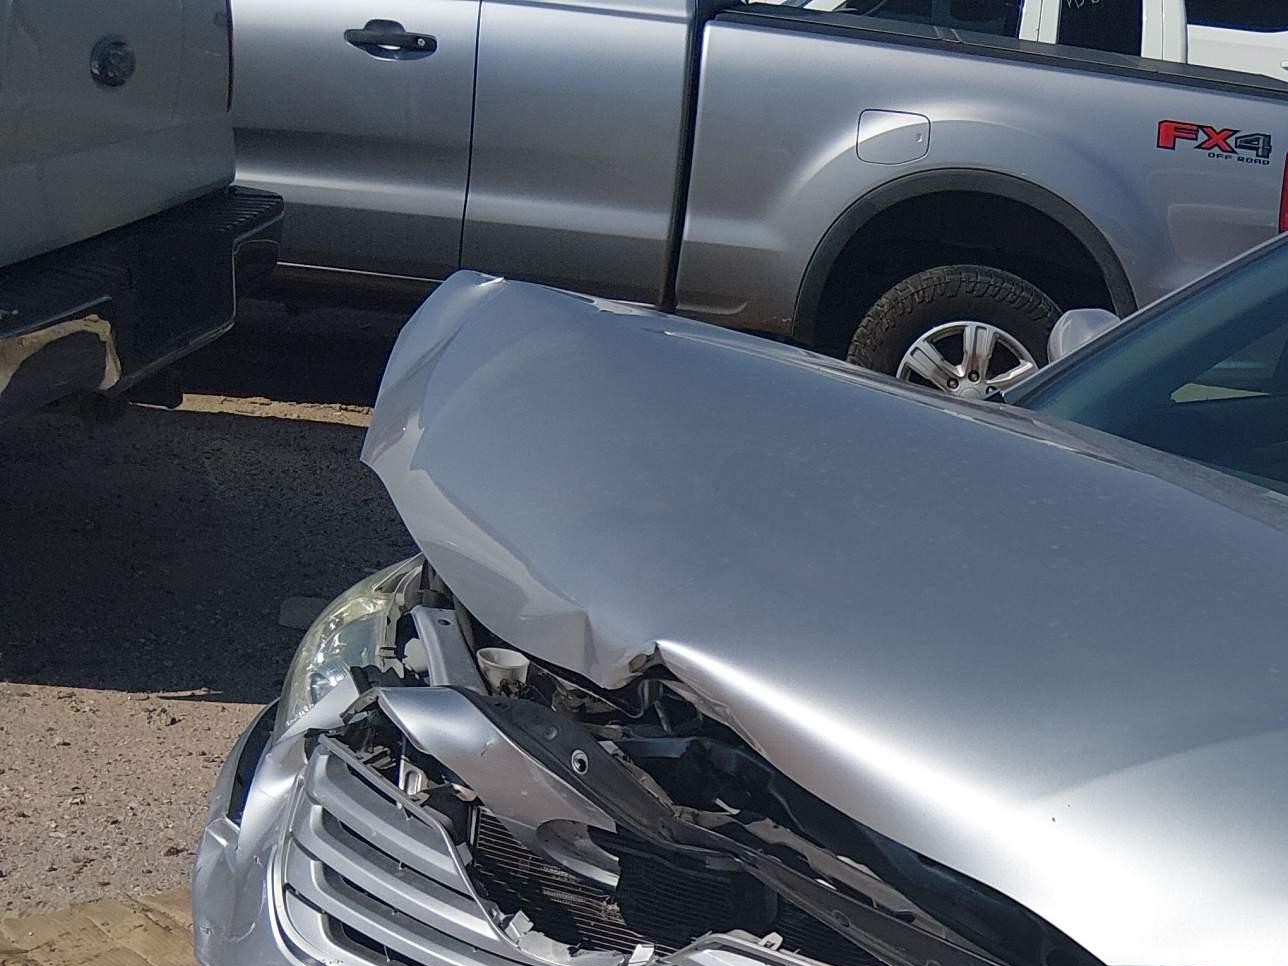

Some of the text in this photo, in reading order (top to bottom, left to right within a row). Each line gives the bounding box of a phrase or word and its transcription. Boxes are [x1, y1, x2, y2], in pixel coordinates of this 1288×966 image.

[1157, 120, 1272, 158] FX4
[1208, 152, 1271, 166] OFF ROAD
